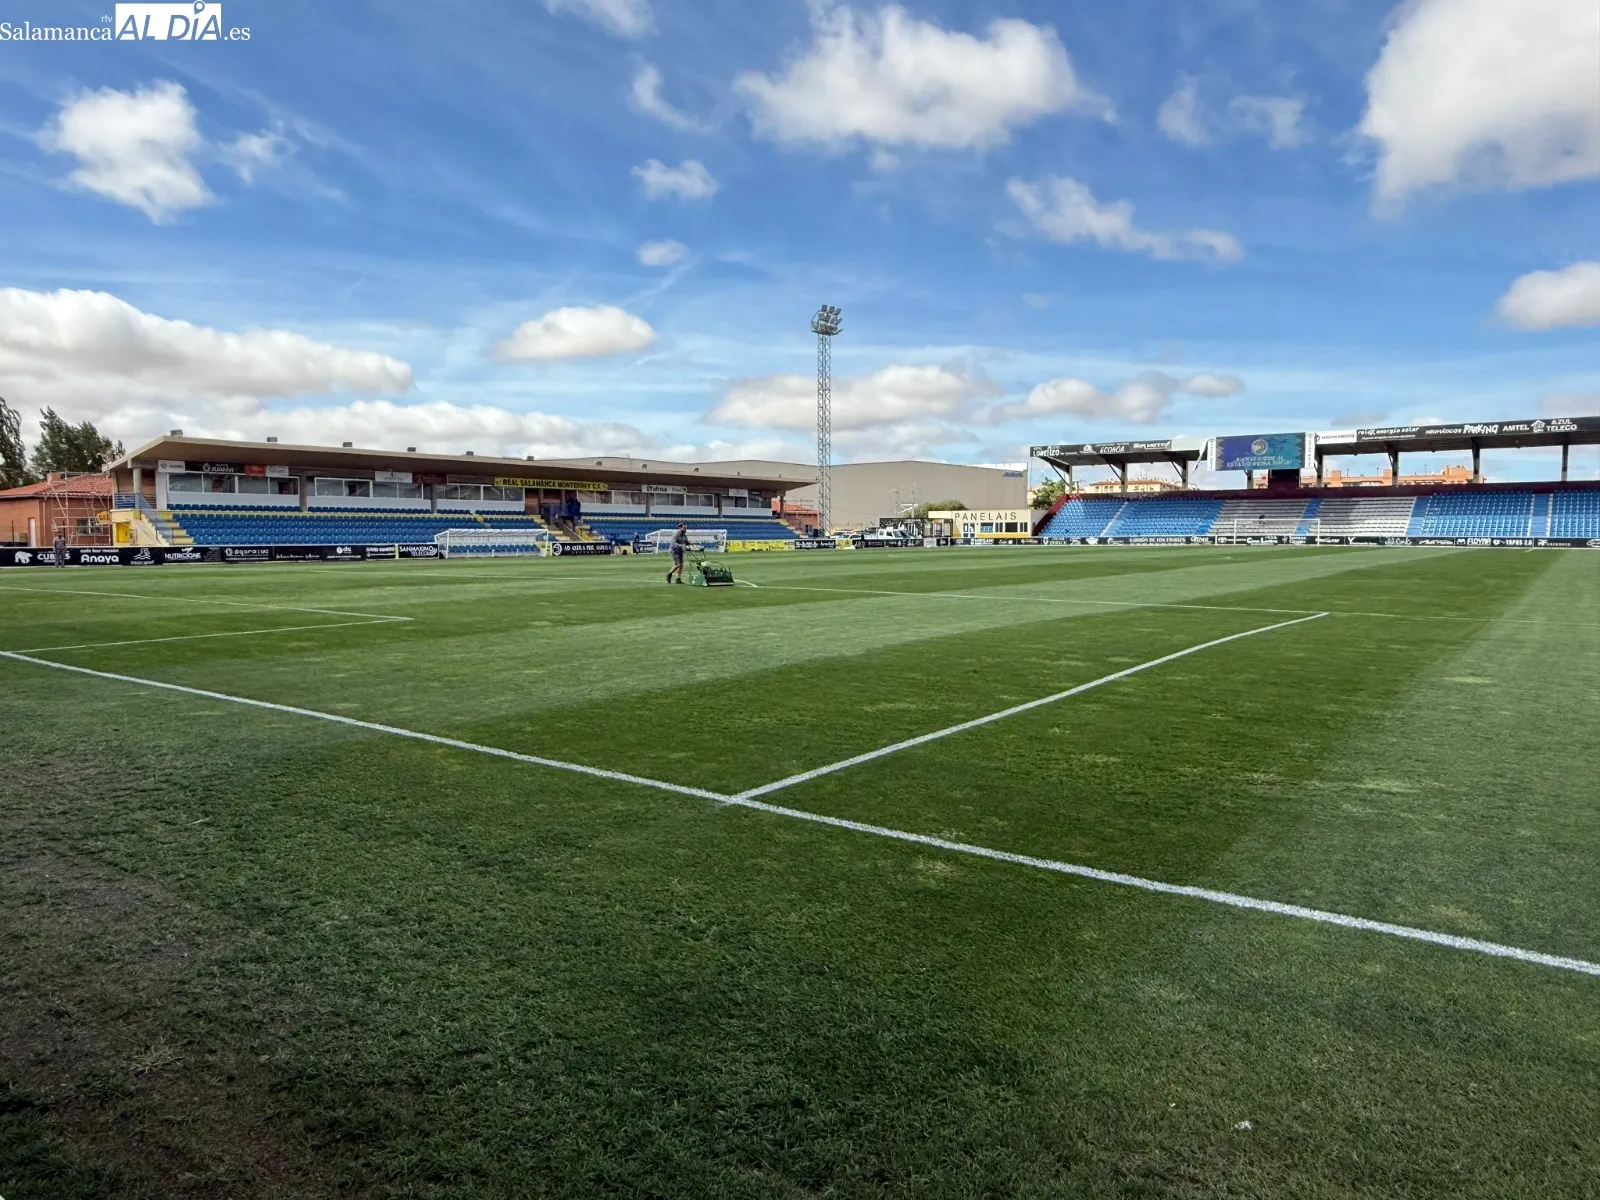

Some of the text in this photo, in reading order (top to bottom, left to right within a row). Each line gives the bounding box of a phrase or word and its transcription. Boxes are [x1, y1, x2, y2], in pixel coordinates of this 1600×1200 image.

[1503, 424, 1530, 432] AMTEL
[1546, 424, 1578, 432] TELECO
[502, 478, 519, 486] REAL
[520, 479, 556, 488] SALAMANCA
[954, 511, 1017, 522] PANELAIS
[81, 554, 120, 564] Anaya
